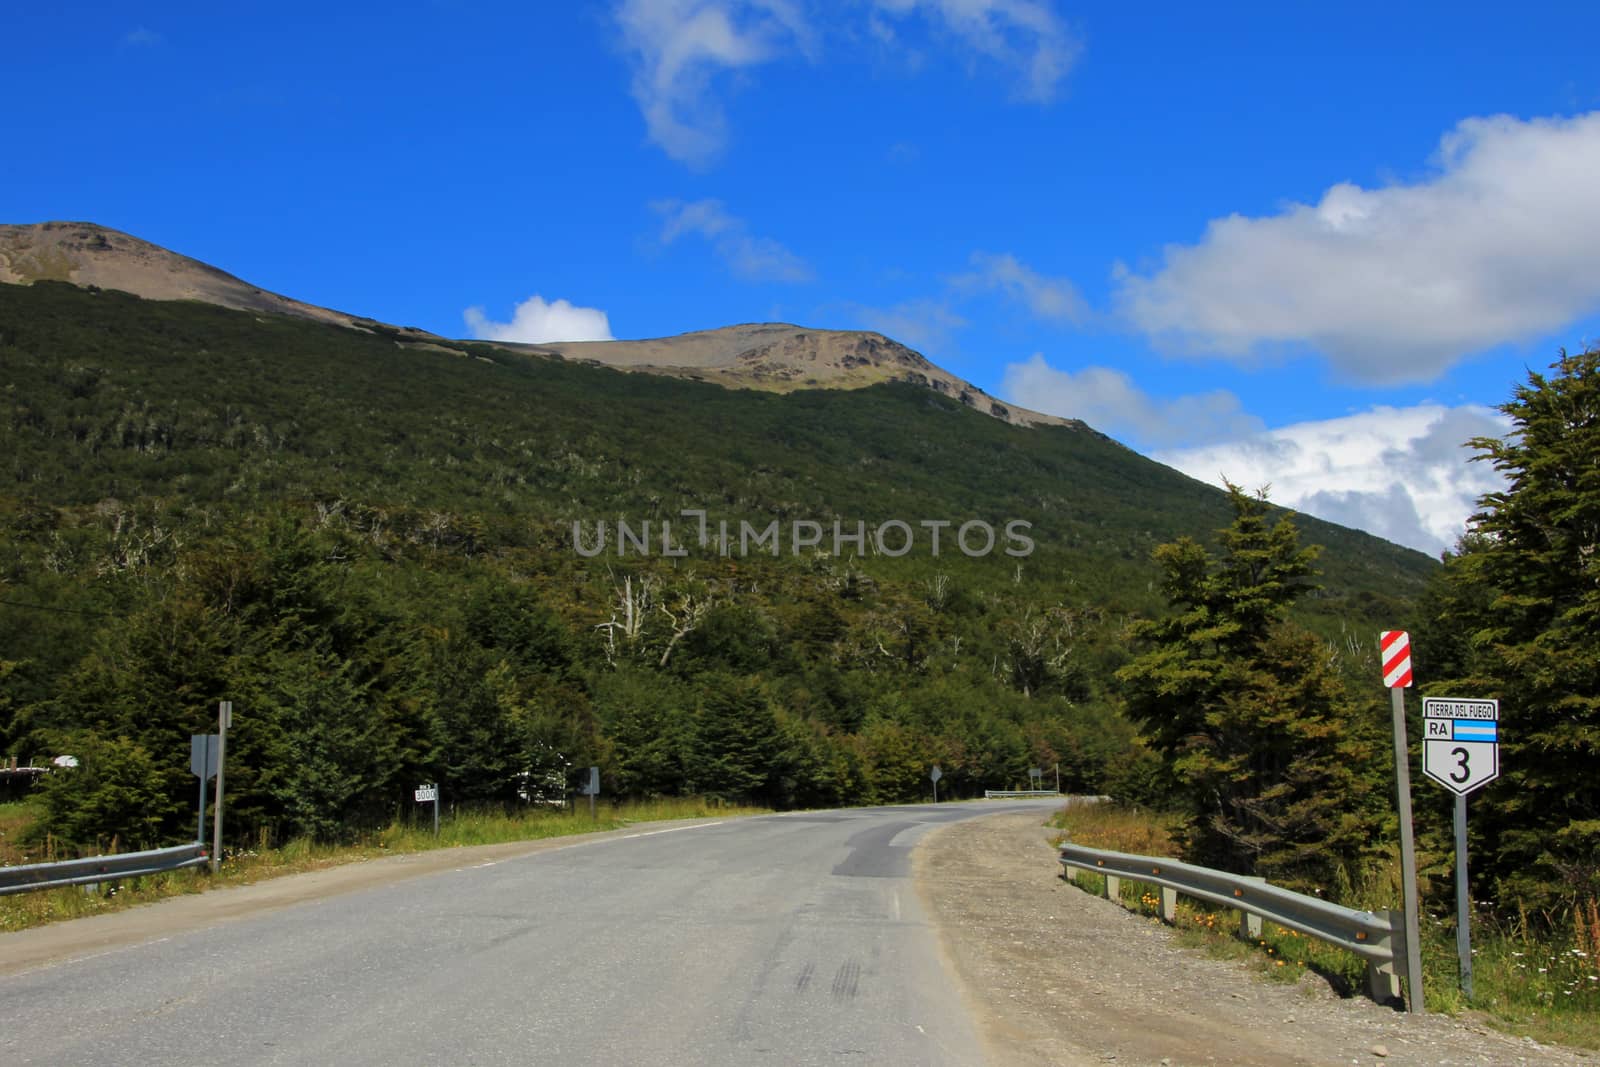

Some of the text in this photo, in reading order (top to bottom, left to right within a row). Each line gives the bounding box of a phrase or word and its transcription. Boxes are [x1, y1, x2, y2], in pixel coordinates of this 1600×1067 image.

[1429, 704, 1492, 718] TIERRA DEL FUEGO
[1429, 722, 1448, 735] RA
[1449, 747, 1471, 784] 3
